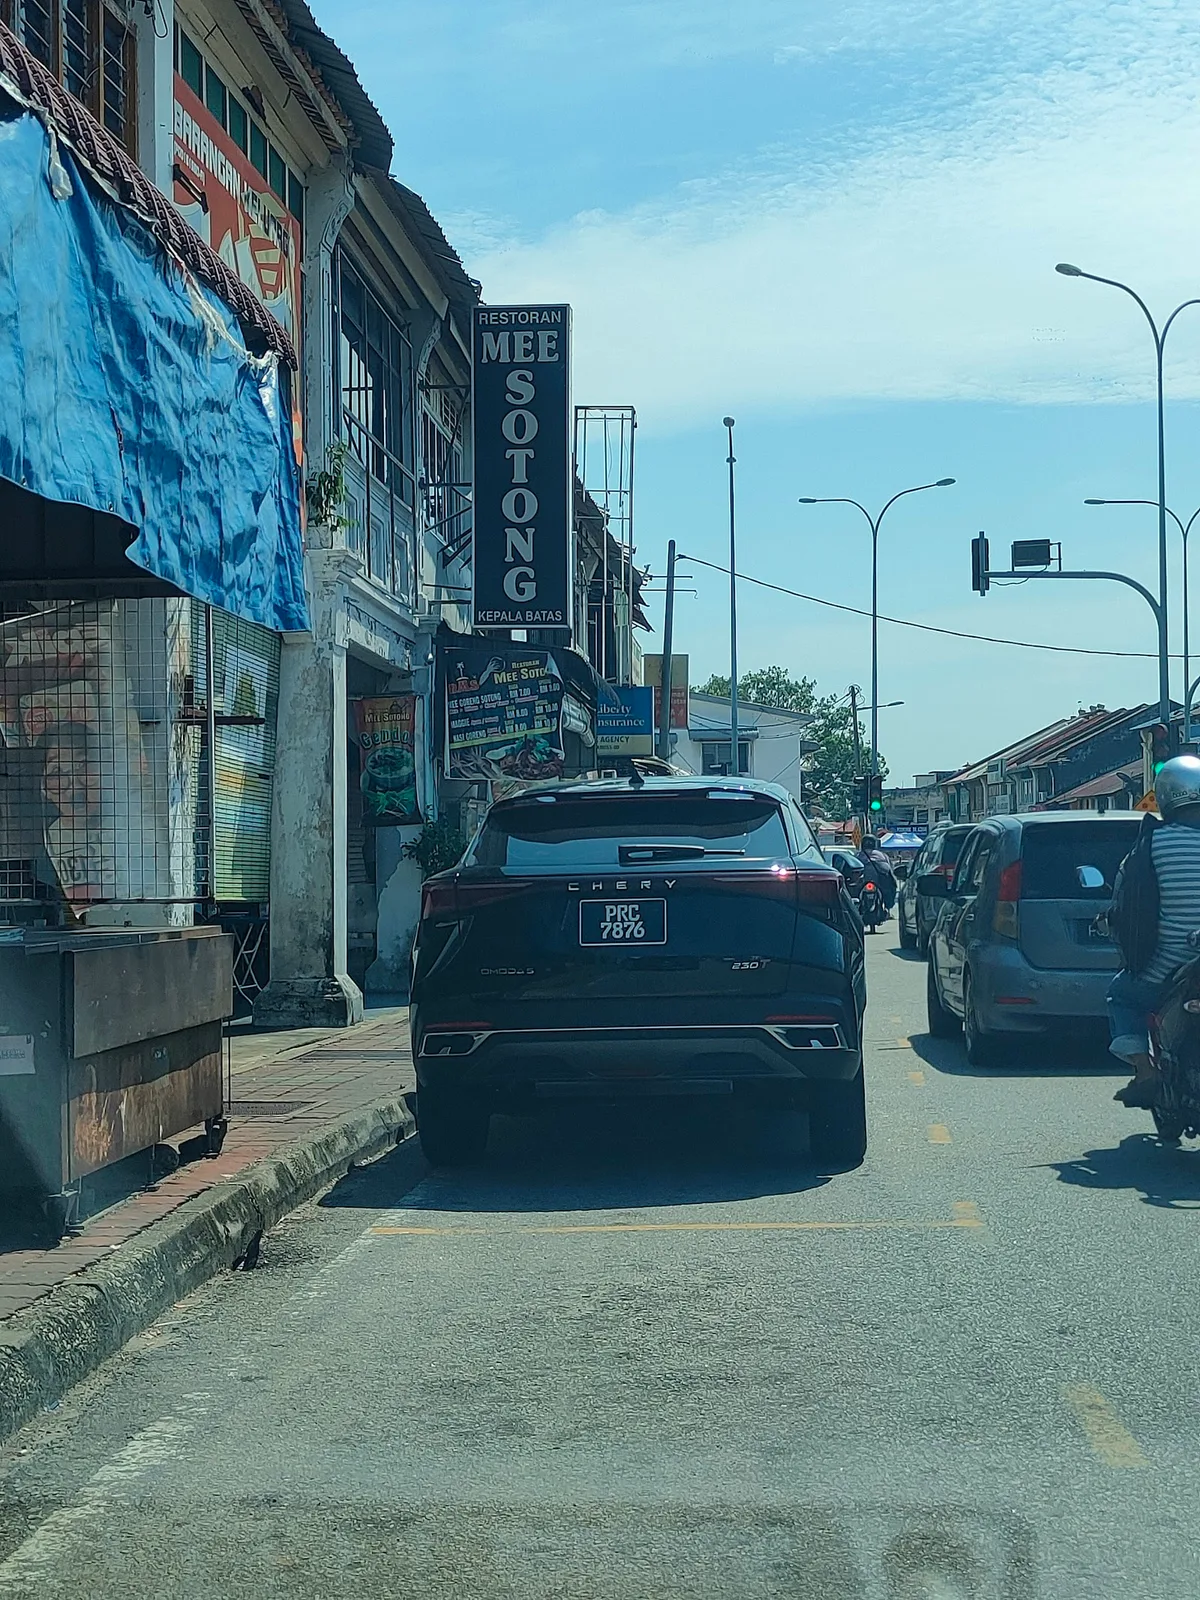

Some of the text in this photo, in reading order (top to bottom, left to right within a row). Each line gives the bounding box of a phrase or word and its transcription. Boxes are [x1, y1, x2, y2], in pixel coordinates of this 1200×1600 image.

[478, 310, 562, 325] RESTORAN
[481, 330, 560, 364] MEE
[502, 369, 539, 603] SOTONG
[478, 610, 563, 622] KEPALA BATAS
[493, 667, 548, 685] MEE SOTO
[597, 718, 645, 727] nsurance
[600, 735, 630, 743] AGENCY
[567, 878, 678, 892] CHERY
[604, 904, 642, 922] PRC
[600, 921, 646, 939] 7876
